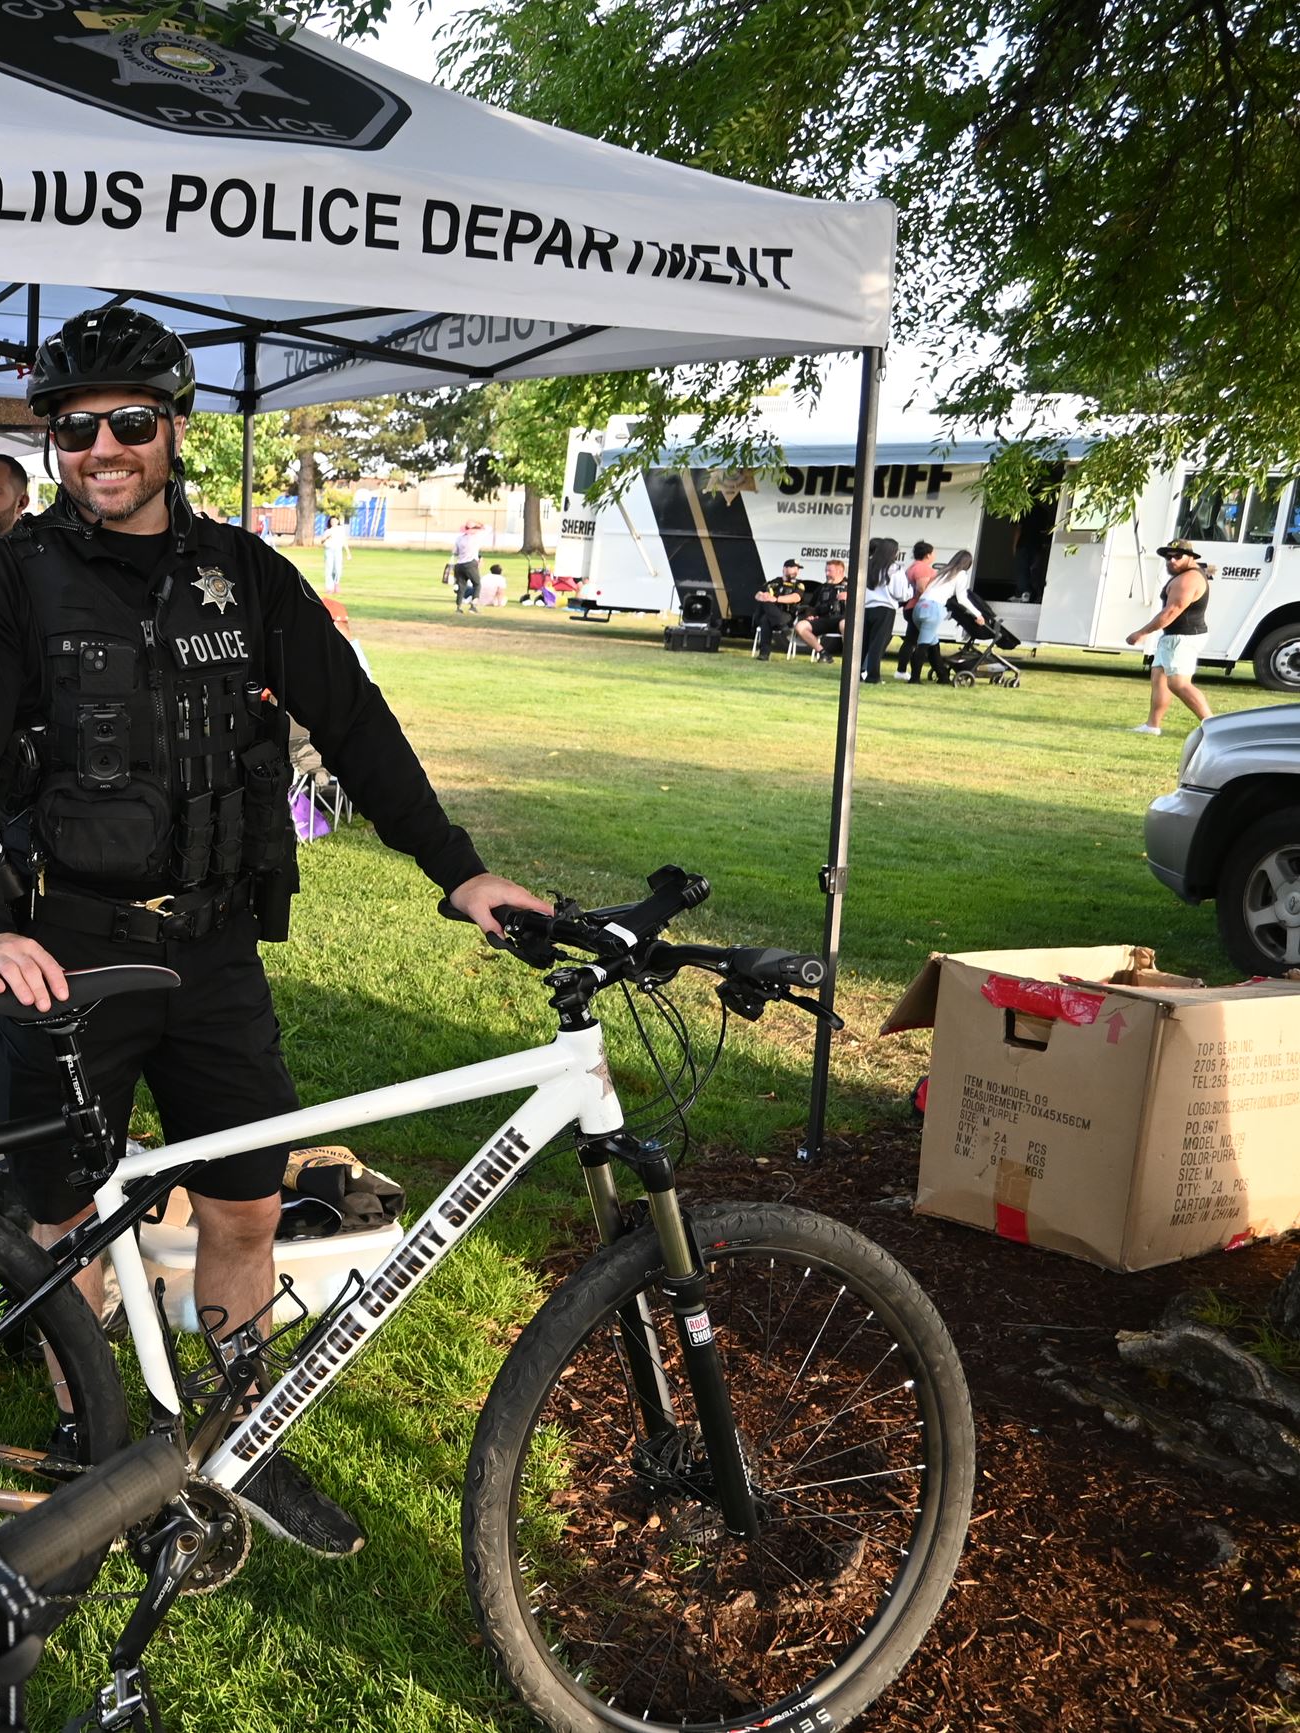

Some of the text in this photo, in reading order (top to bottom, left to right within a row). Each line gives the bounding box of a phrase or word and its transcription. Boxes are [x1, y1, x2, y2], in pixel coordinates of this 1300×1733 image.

[156, 106, 348, 139] POLICE
[165, 173, 402, 250] POLICE
[422, 199, 794, 291] DEPARTMENT
[777, 501, 945, 519] WASHINGT COUNTY
[801, 547, 828, 558] CRISIS
[1222, 566, 1261, 578] SHERIFF
[62, 640, 74, 651] B.
[175, 630, 249, 665] POLICE
[1197, 1042, 1215, 1056] TOP
[1217, 1041, 1238, 1056] GEAR
[1193, 1059, 1216, 1073] 2705
[1220, 1056, 1251, 1072] PACIFIC
[1254, 1053, 1282, 1069] AVENUE
[964, 1073, 983, 1089] ITEM
[1034, 1094, 1049, 1107] 09
[959, 1109, 990, 1127] SIZE: M
[961, 1097, 1019, 1125] COLOR:PURPLE
[994, 1131, 1007, 1144] 24
[1027, 1140, 1047, 1156] PCS
[1182, 1136, 1215, 1150] MODEL
[1026, 1152, 1046, 1168] KGS
[1180, 1147, 1243, 1166] COLOR:PURPLE
[1024, 1164, 1044, 1180] KGS
[1178, 1166, 1213, 1182] SIZE: M
[1211, 1180, 1223, 1194] 24
[1233, 1177, 1250, 1192] PCS
[1174, 1196, 1212, 1212] CARTON
[1169, 1207, 1240, 1227] MADE IN CHINA
[230, 1125, 531, 1462] WASHINGTON COUNTY SHERIFF
